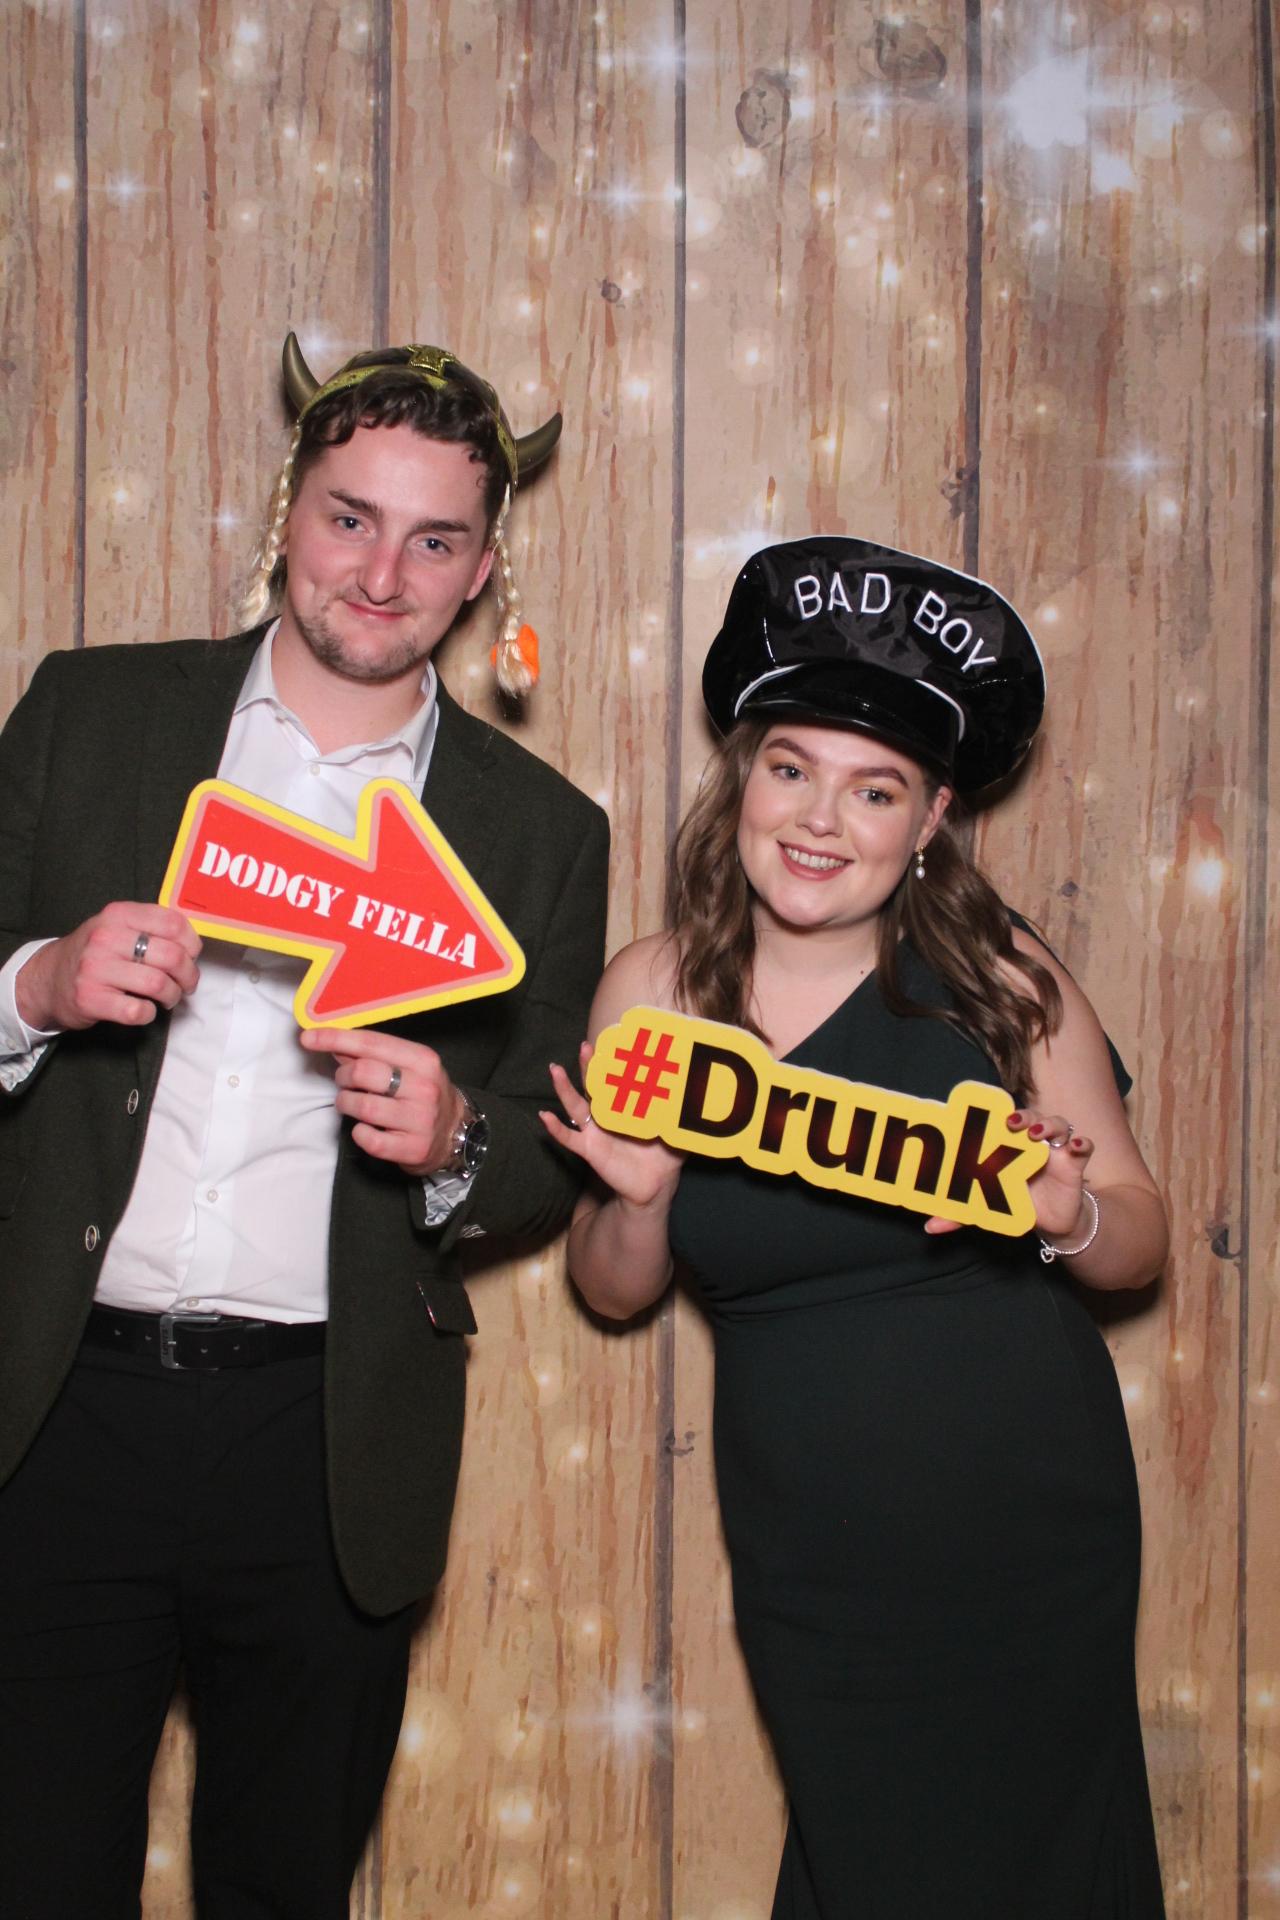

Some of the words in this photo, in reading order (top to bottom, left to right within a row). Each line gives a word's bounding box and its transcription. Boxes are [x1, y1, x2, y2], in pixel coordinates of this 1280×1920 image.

[794, 572, 892, 620] BAD
[913, 590, 998, 673] BOY
[198, 841, 344, 918] DODGY
[348, 894, 477, 969] FELLA
[604, 1027, 1026, 1216] #Drunk
